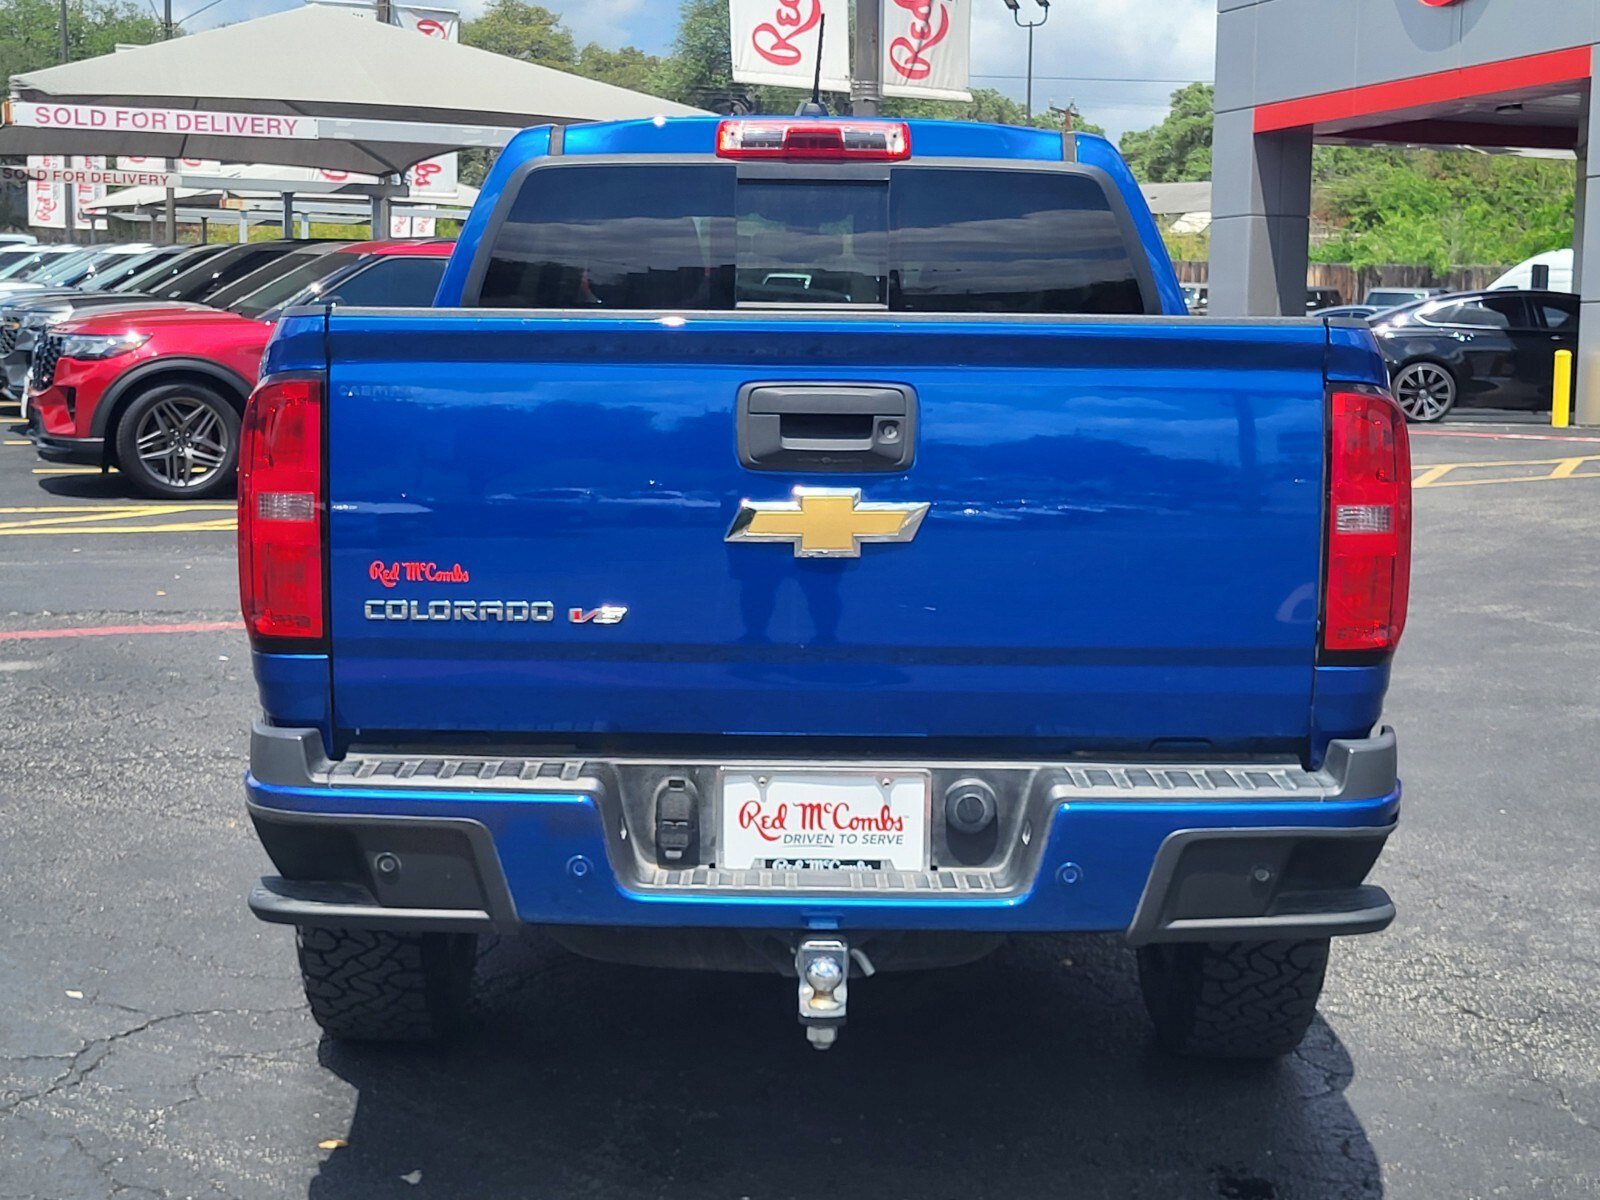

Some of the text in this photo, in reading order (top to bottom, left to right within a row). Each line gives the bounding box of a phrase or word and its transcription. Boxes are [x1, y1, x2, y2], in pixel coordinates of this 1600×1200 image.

[35, 105, 298, 136] SOLD FOR DELIVERY
[2, 167, 170, 186] SOLD FOR DELIVERY
[369, 560, 470, 587] Red McCombs
[364, 599, 554, 622] COLORADO
[739, 800, 904, 842] Red McCombs
[783, 833, 904, 846] DRIVEN TO SERVE
